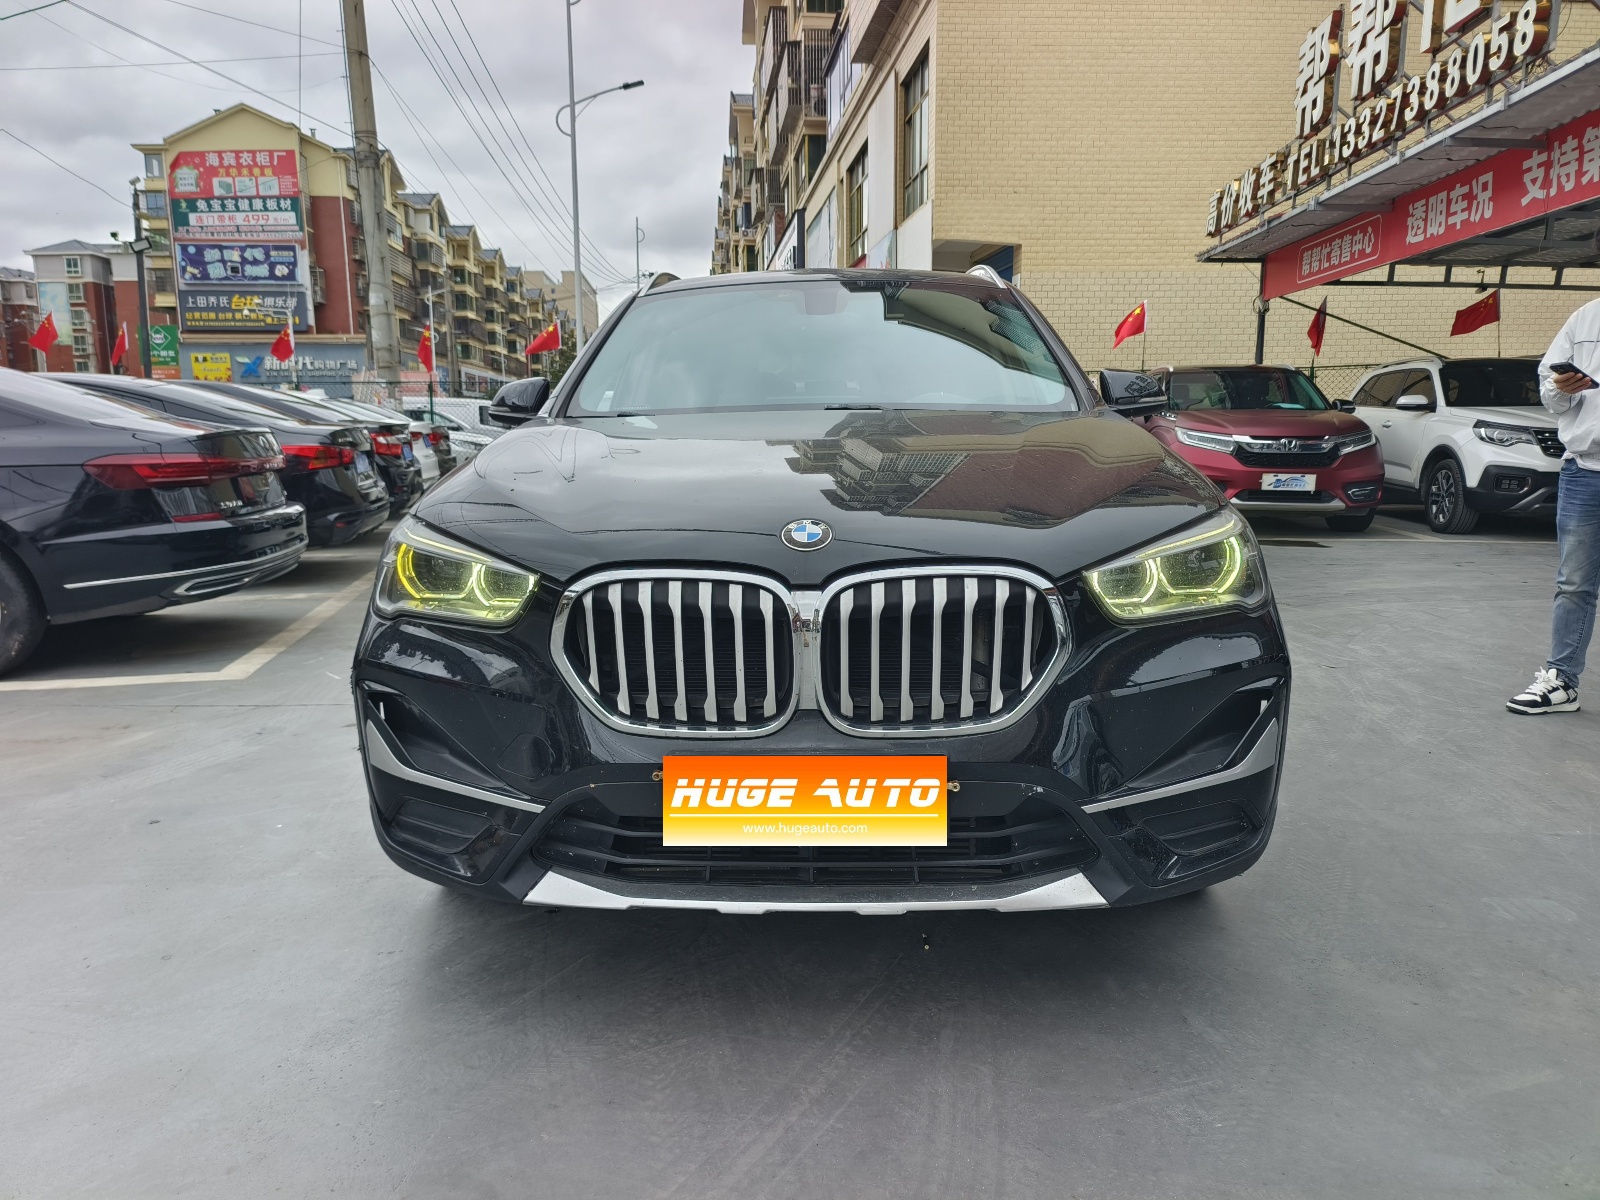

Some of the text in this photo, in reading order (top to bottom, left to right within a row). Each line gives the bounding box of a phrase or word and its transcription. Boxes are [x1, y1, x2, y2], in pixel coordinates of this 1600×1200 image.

[1205, 0, 1537, 237] 高价收车 TEL:13327388058
[196, 198, 292, 212] 兔宝宝健康板材
[242, 214, 270, 224] 499
[1405, 171, 1494, 246] 透明车况
[1302, 226, 1375, 276] 帮帮忙寄售中心
